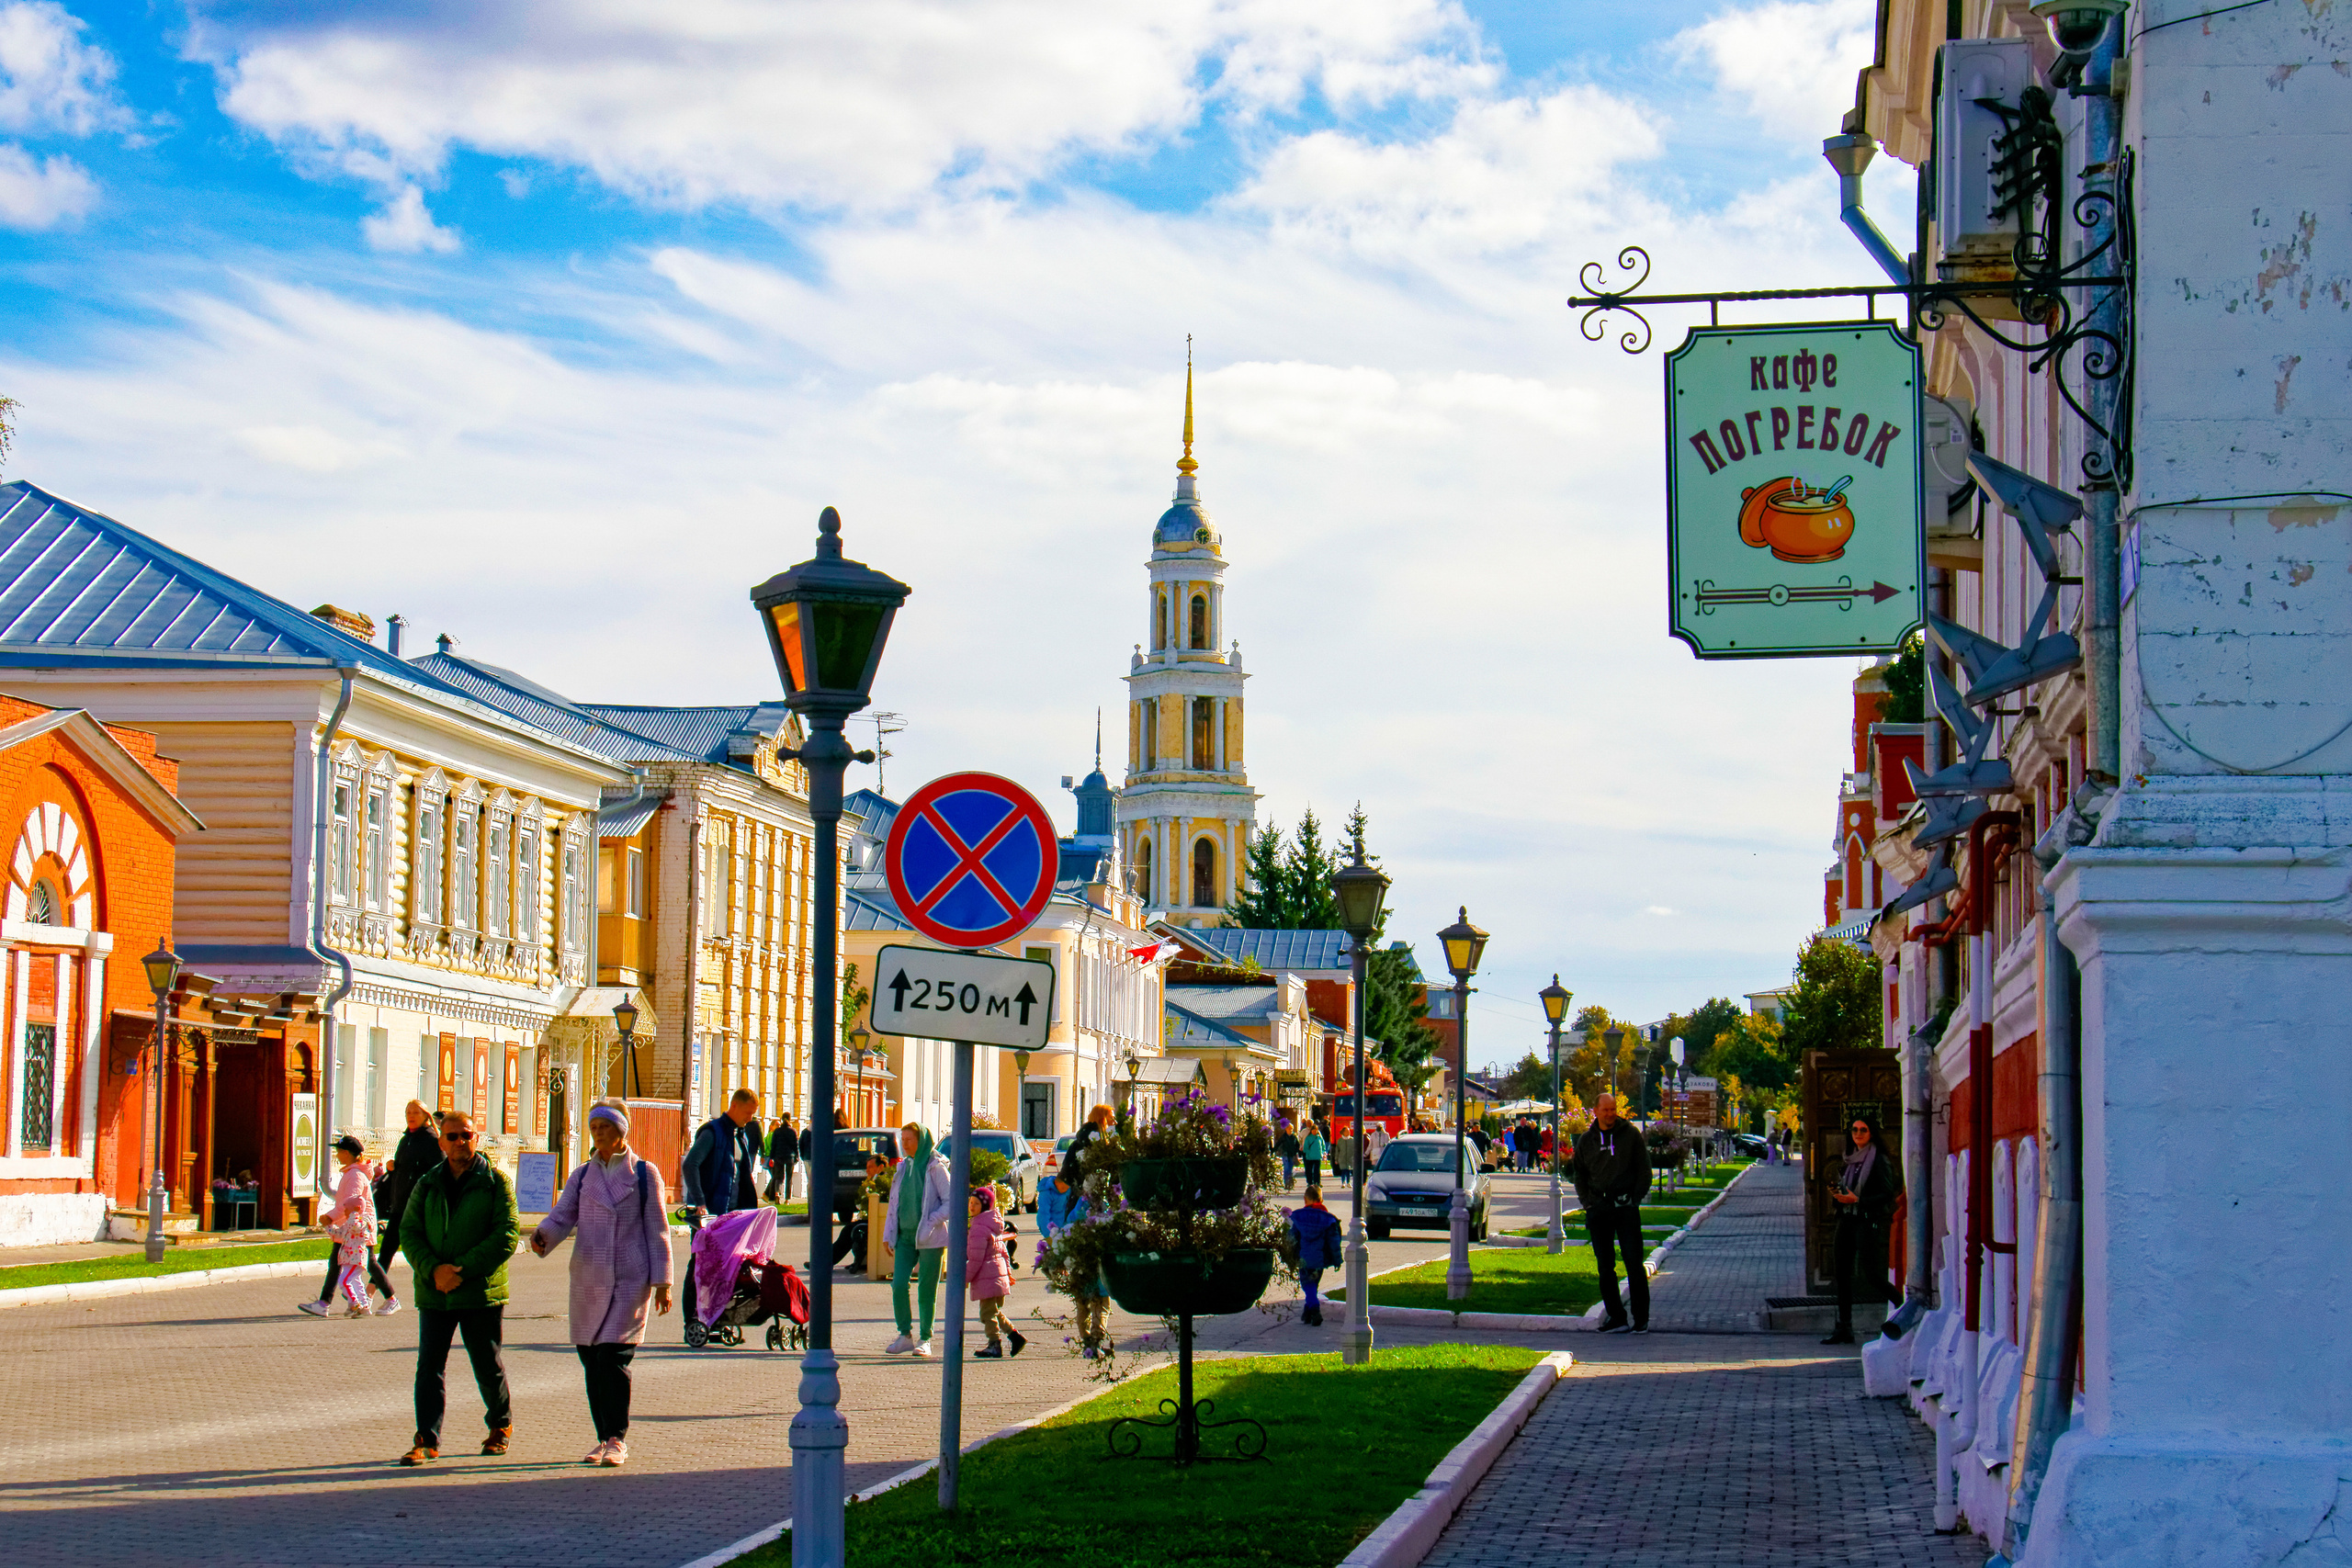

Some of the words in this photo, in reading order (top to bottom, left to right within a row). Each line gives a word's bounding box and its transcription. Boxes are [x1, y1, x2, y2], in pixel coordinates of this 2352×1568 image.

[1750, 348, 1838, 393] кафе
[1689, 405, 1902, 476] ПОГРЕБОК
[910, 978, 980, 1014] 250
[294, 1100, 315, 1111] ЧЕКАНКА
